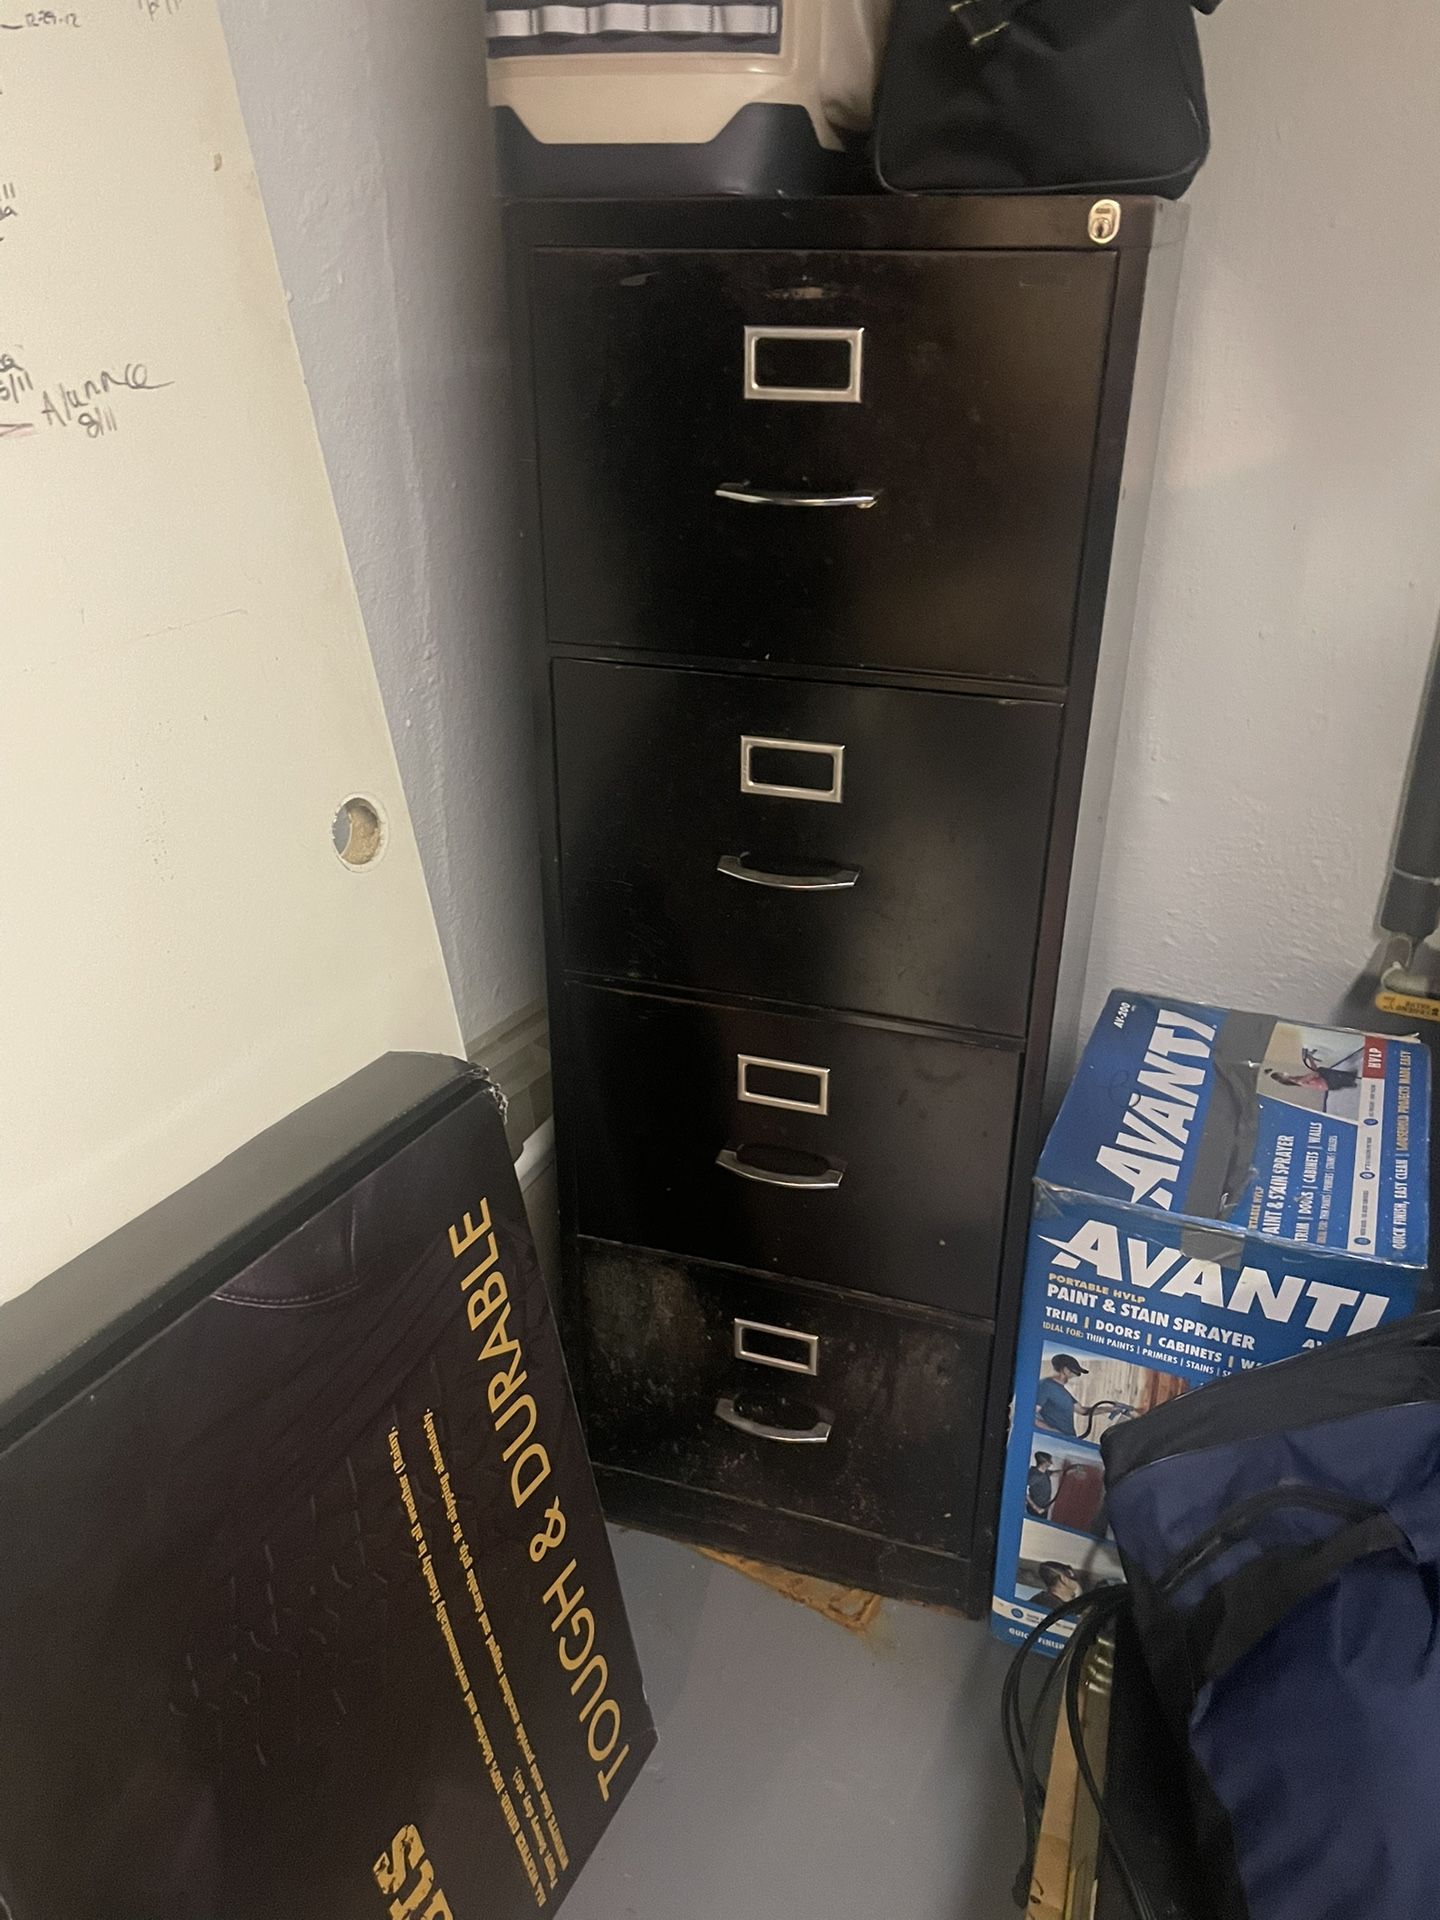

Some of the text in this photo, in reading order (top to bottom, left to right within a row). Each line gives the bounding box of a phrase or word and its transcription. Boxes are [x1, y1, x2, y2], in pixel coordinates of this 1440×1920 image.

[1096, 1009, 1216, 1211] AVANTI
[1308, 1121, 1322, 1145] WALLS
[1273, 1135, 1295, 1174] SPRAYER
[1267, 1199, 1284, 1210] &
[1262, 1211, 1282, 1235] AINT
[1392, 1226, 1407, 1250] QUICK
[1037, 1219, 1390, 1337] AVANTI
[1048, 1272, 1146, 1304] PORTABLE HVLP
[1045, 1306, 1078, 1324] TRIM
[1095, 1319, 1142, 1341] DOORS
[1158, 1337, 1222, 1362] CABINETS
[1047, 1283, 1256, 1351] PAINT & STAIN SPRAYER
[1086, 1333, 1105, 1345] THIN
[1107, 1338, 1135, 1353] PAINTS
[1142, 1348, 1178, 1365] PRIMERS
[1186, 1360, 1214, 1375] STAINS
[398, 1473, 418, 1524] weather
[448, 1198, 632, 1803] TOUGH & DURABLE
[410, 1522, 424, 1541] all
[417, 1539, 428, 1558] in
[1008, 1627, 1030, 1640] QUIC
